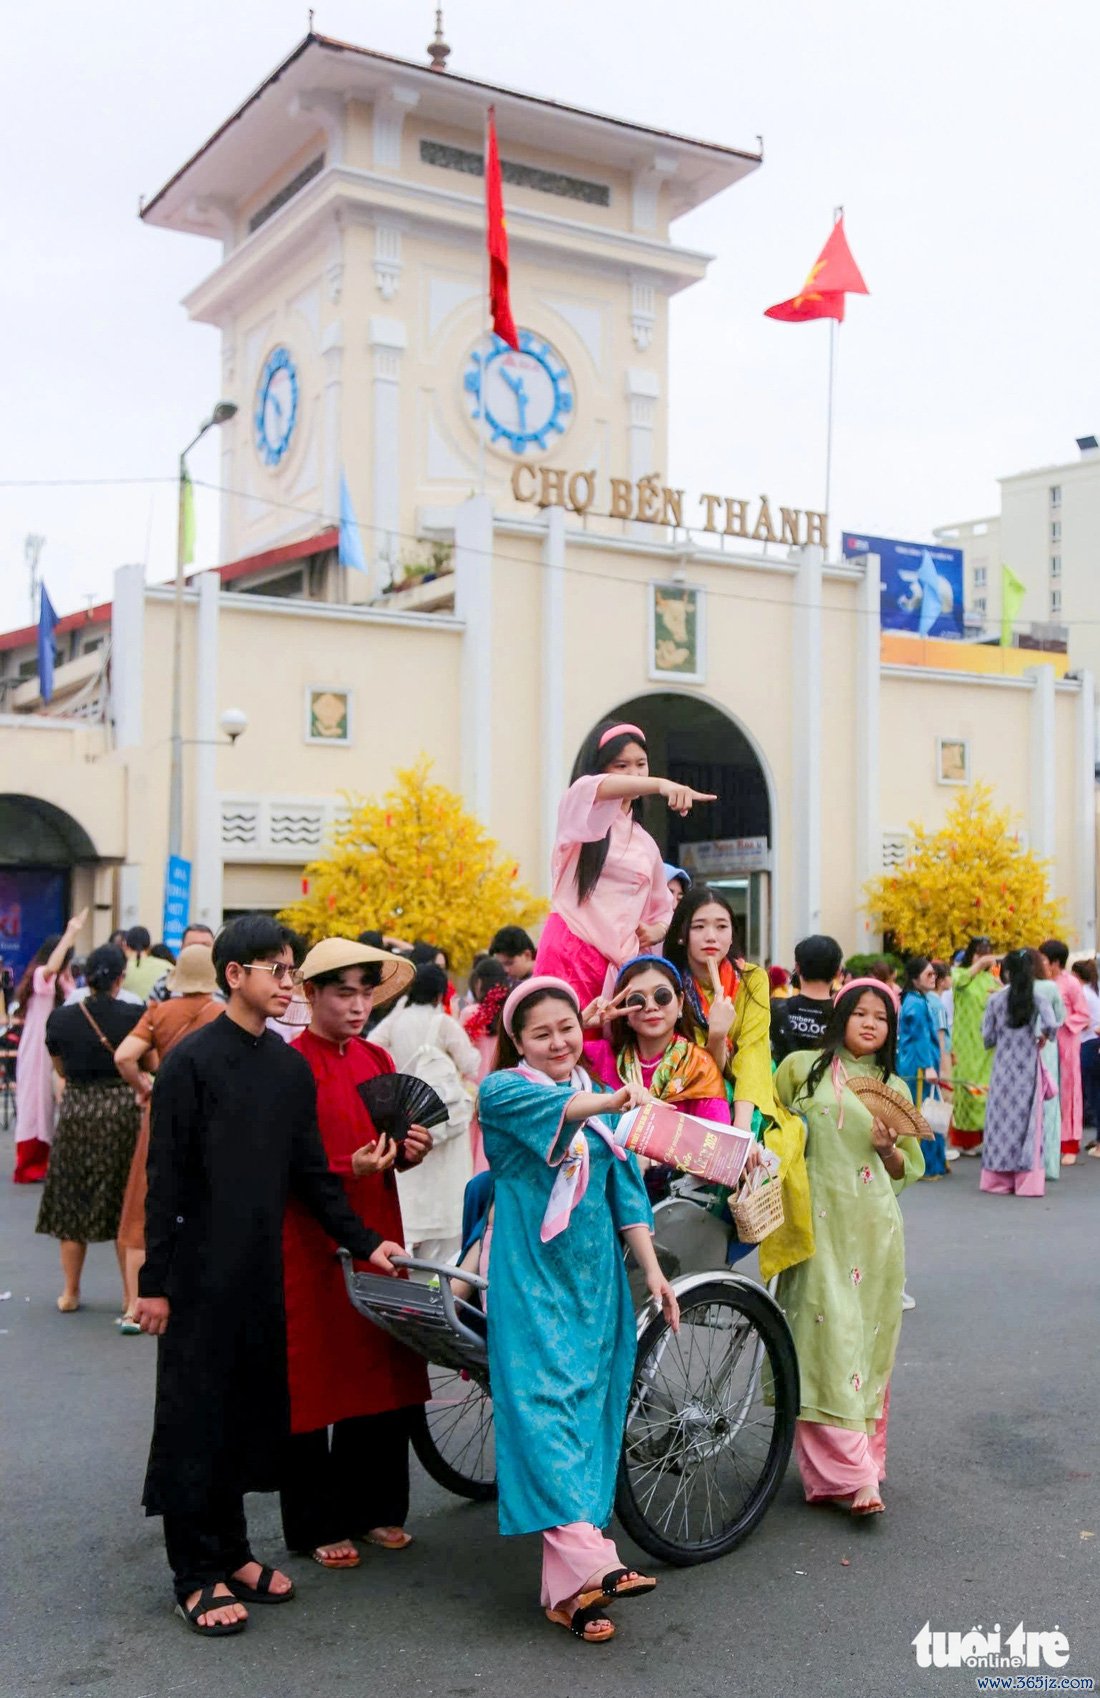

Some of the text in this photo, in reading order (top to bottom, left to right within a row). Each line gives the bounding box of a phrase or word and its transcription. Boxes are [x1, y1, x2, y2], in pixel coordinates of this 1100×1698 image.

[511, 462, 828, 548] CHỢ BẾN THÀNH
